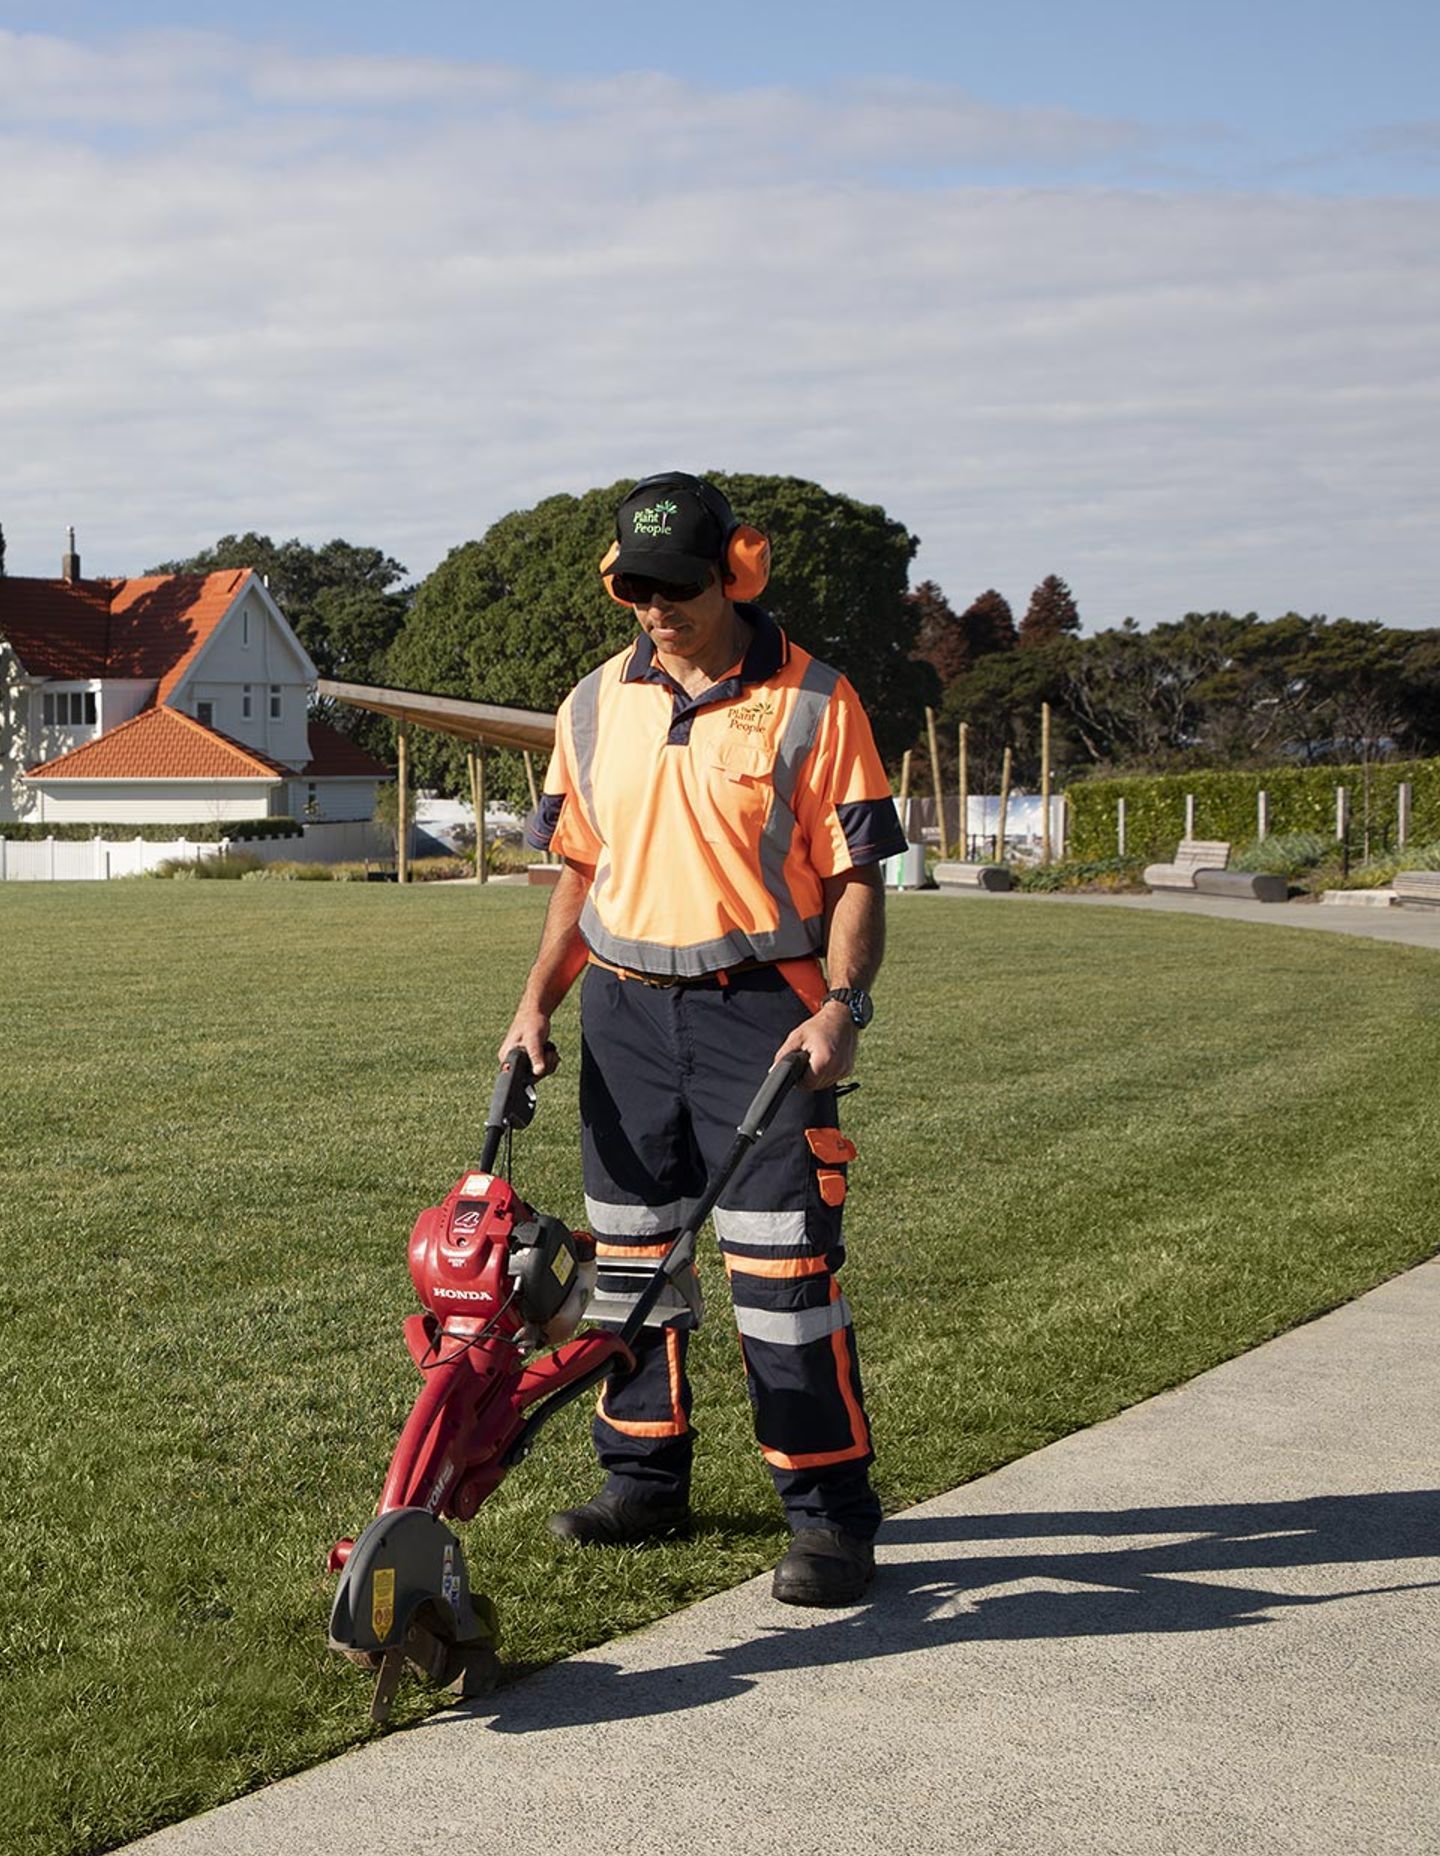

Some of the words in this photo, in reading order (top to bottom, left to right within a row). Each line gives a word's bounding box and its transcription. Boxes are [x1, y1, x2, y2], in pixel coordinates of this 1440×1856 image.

[633, 511, 659, 523] Plant
[634, 522, 672, 537] People
[728, 708, 756, 721] Plant
[730, 719, 766, 735] People
[433, 1287, 493, 1301] HONDA
